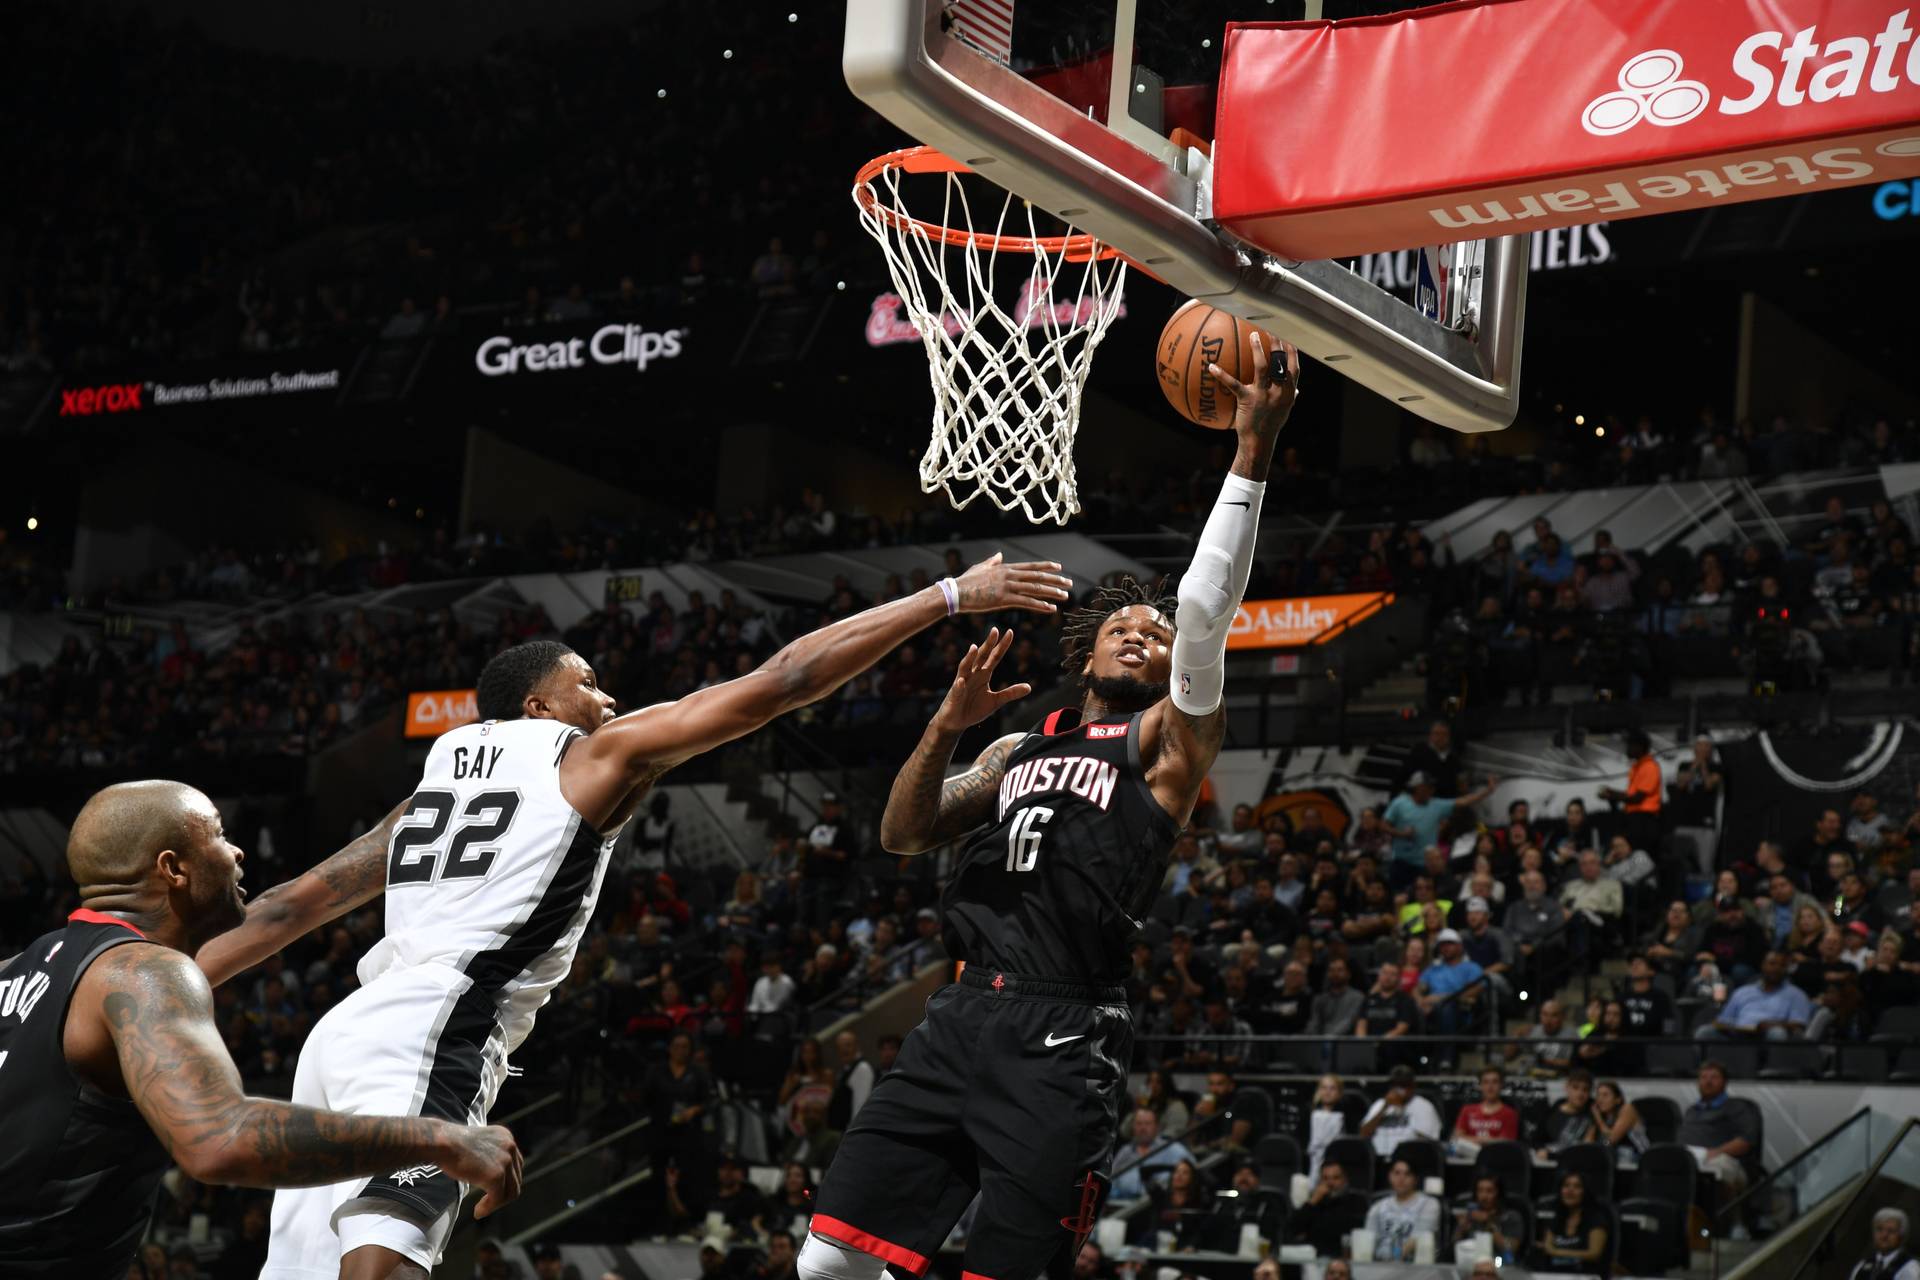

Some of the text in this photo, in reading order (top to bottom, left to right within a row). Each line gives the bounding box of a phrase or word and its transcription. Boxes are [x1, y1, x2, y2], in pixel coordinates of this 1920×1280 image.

[475, 323, 682, 376] Great Clips
[59, 369, 339, 417] xerox Business Solutions Southwest
[1254, 601, 1338, 633] Ashley
[454, 745, 504, 780] GAY
[999, 756, 1120, 824] HOUSTON
[387, 787, 524, 889] 22
[1006, 806, 1055, 873] 16
